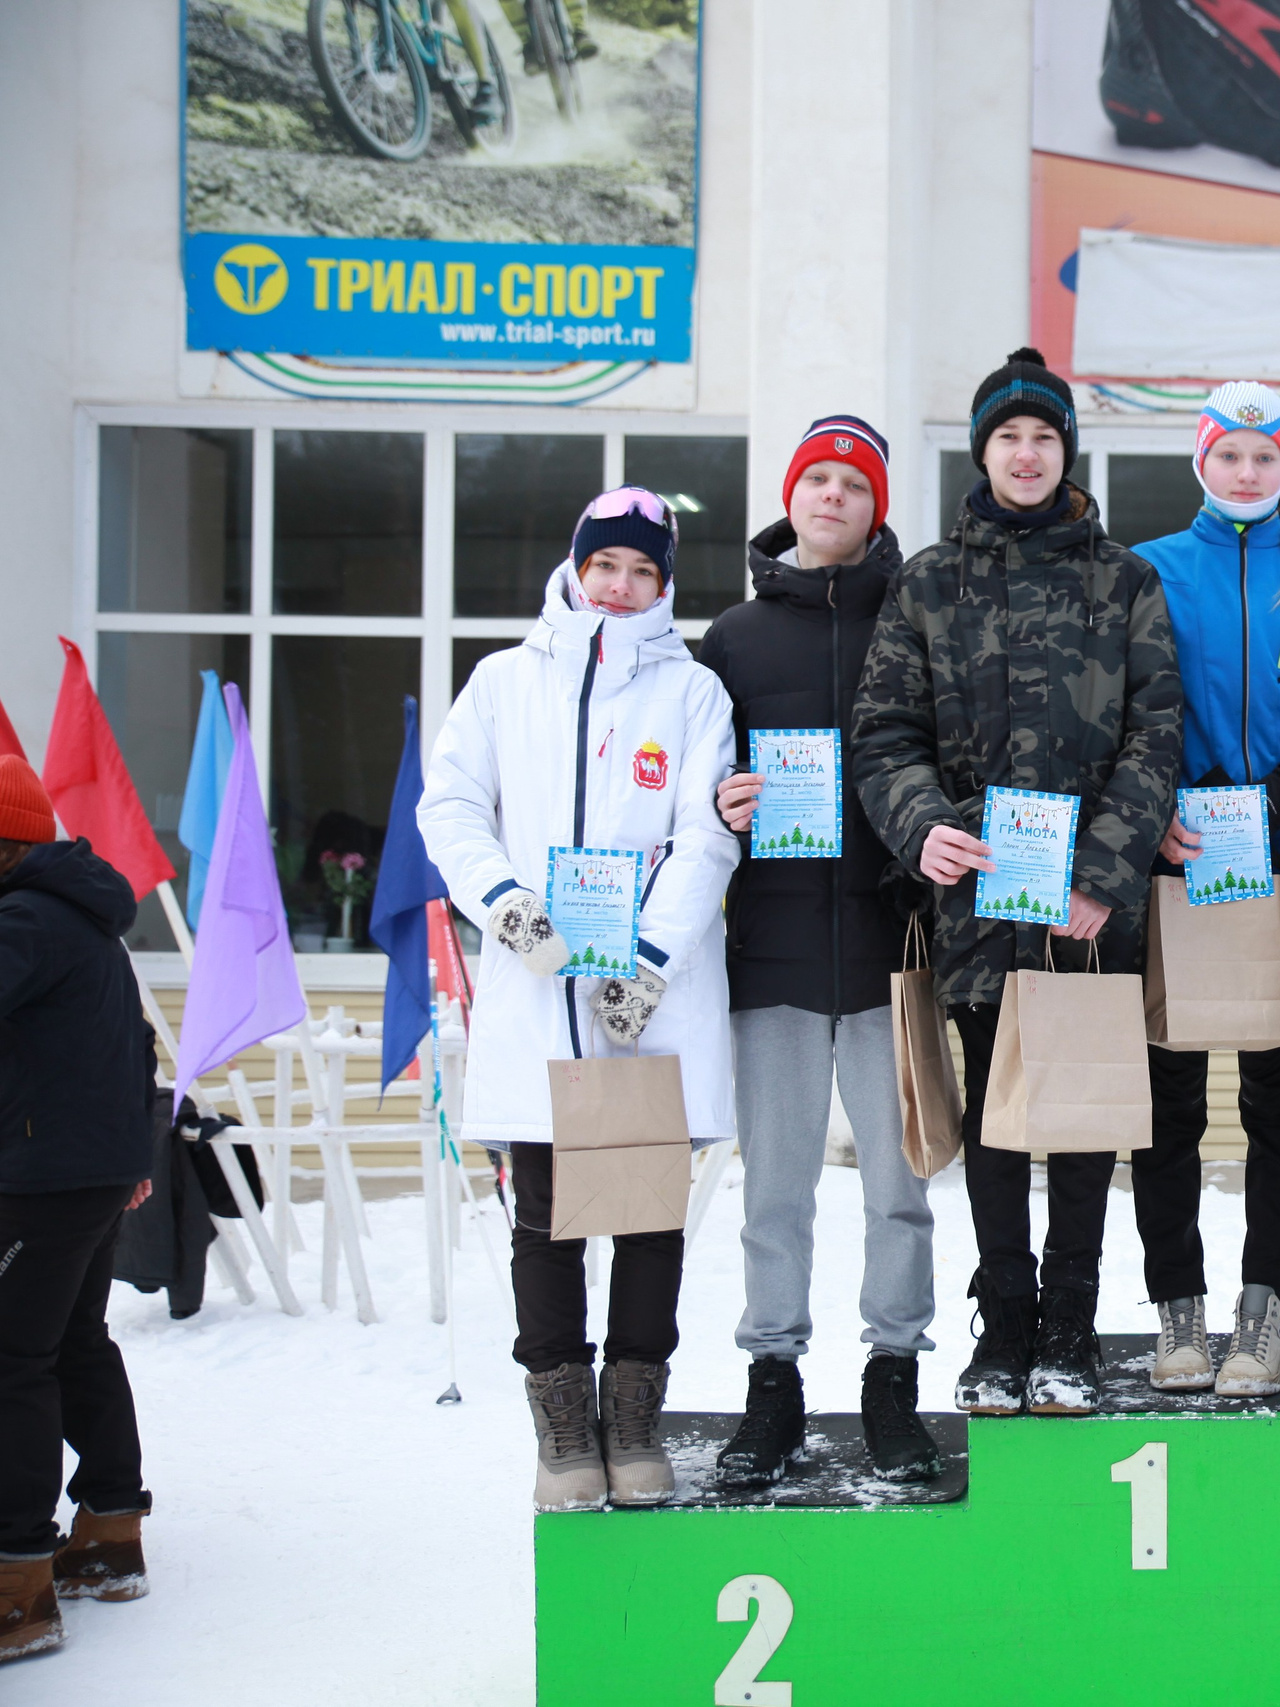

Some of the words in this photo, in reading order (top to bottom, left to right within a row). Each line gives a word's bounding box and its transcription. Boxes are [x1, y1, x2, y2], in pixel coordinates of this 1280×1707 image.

[440, 320, 656, 348] www.trial-sport.ru
[768, 764, 825, 774] ГРАМОТА
[1195, 812, 1251, 824] ГРАМОТА
[999, 823, 1058, 840] ГРАМОТА
[563, 883, 624, 895] ГРАМОТА
[1110, 1442, 1167, 1570] 1
[714, 1573, 794, 1707] 2
